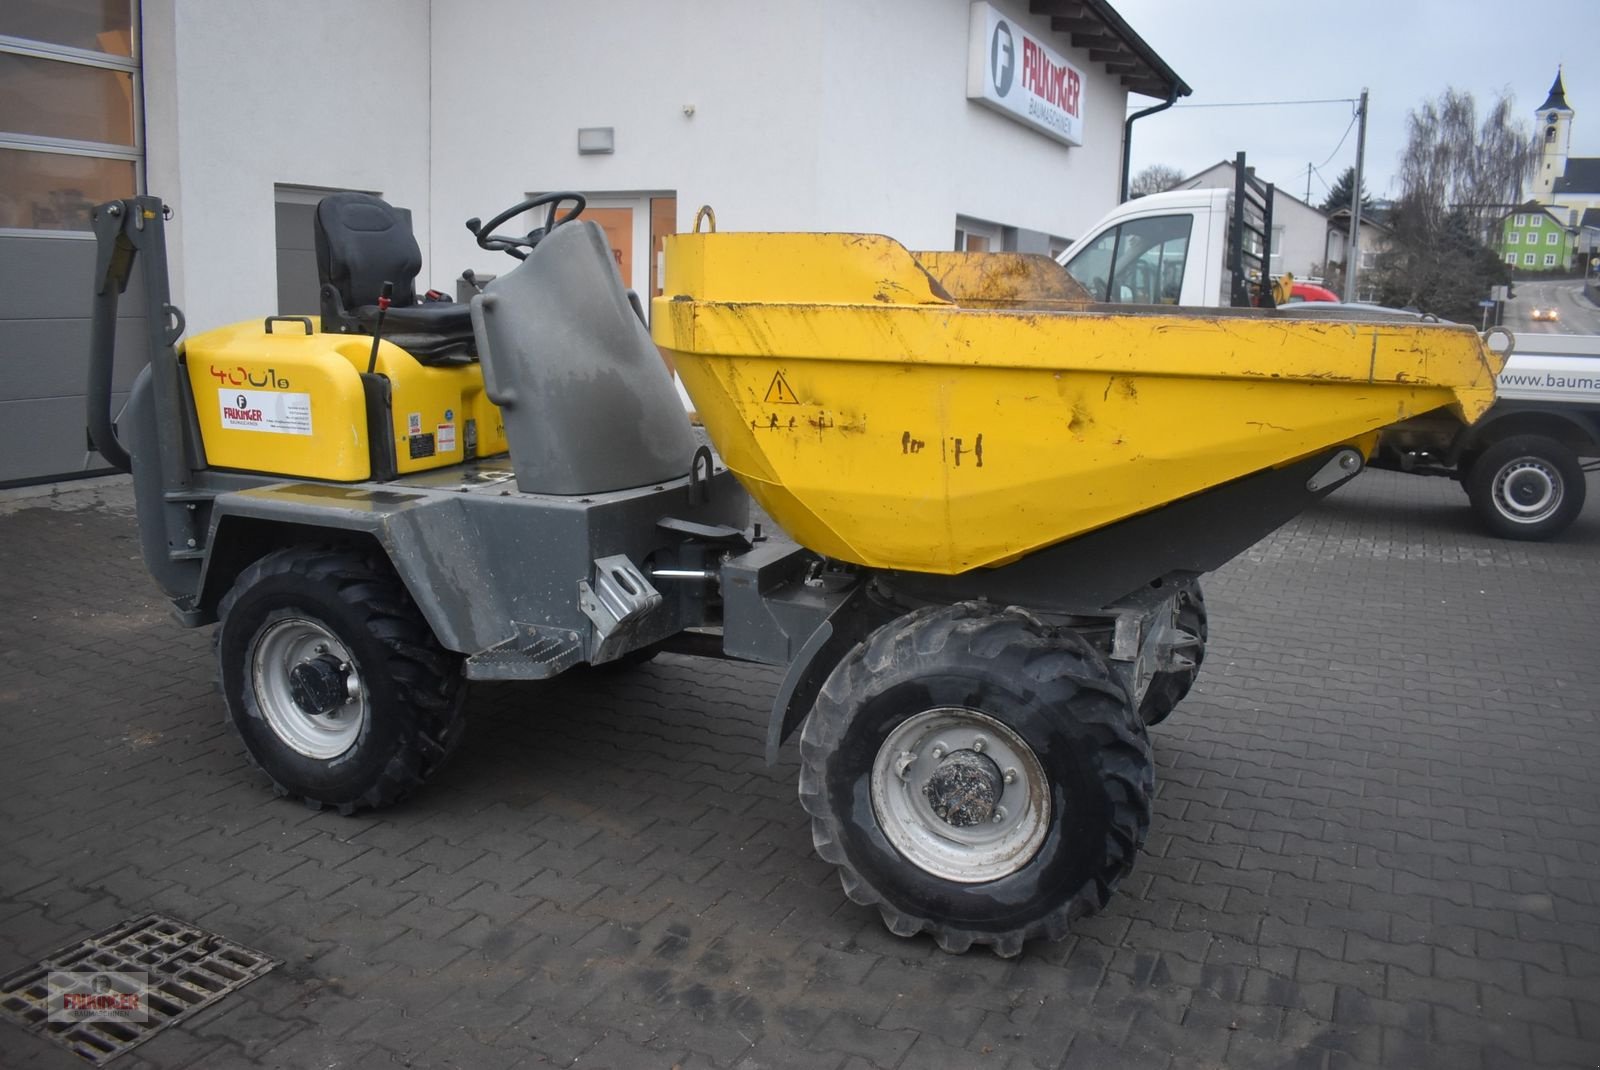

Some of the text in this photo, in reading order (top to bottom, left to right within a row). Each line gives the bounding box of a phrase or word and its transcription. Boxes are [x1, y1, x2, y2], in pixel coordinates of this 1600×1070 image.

[1022, 35, 1080, 119] FALKINGER
[1500, 373, 1600, 390] www.bauma
[223, 407, 262, 422] FALKINGER
